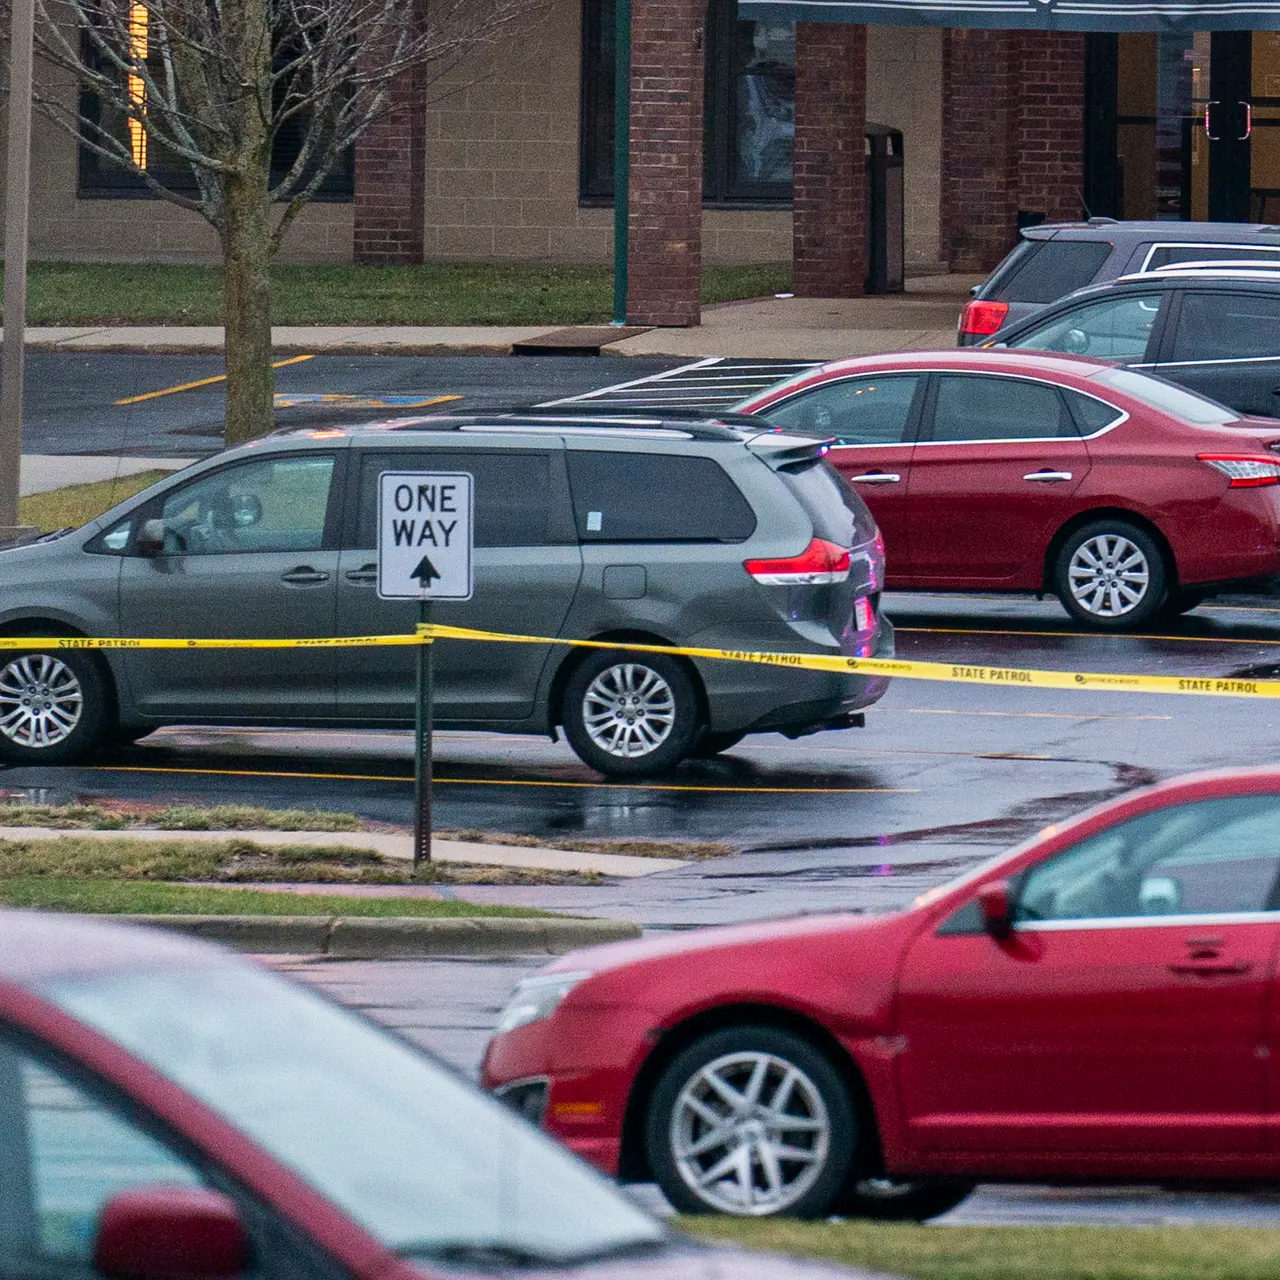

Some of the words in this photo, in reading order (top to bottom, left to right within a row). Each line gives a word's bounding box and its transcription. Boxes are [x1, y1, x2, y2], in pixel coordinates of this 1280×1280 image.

[394, 484, 457, 513] ONE
[393, 519, 458, 548] WAY
[58, 639, 94, 649] STATE
[721, 651, 755, 662] STATE
[759, 652, 804, 665] PATROL
[952, 666, 986, 679] STATE
[989, 669, 1032, 682] PATROL
[1178, 679, 1212, 691] STATE
[1216, 681, 1259, 693] PATROL
